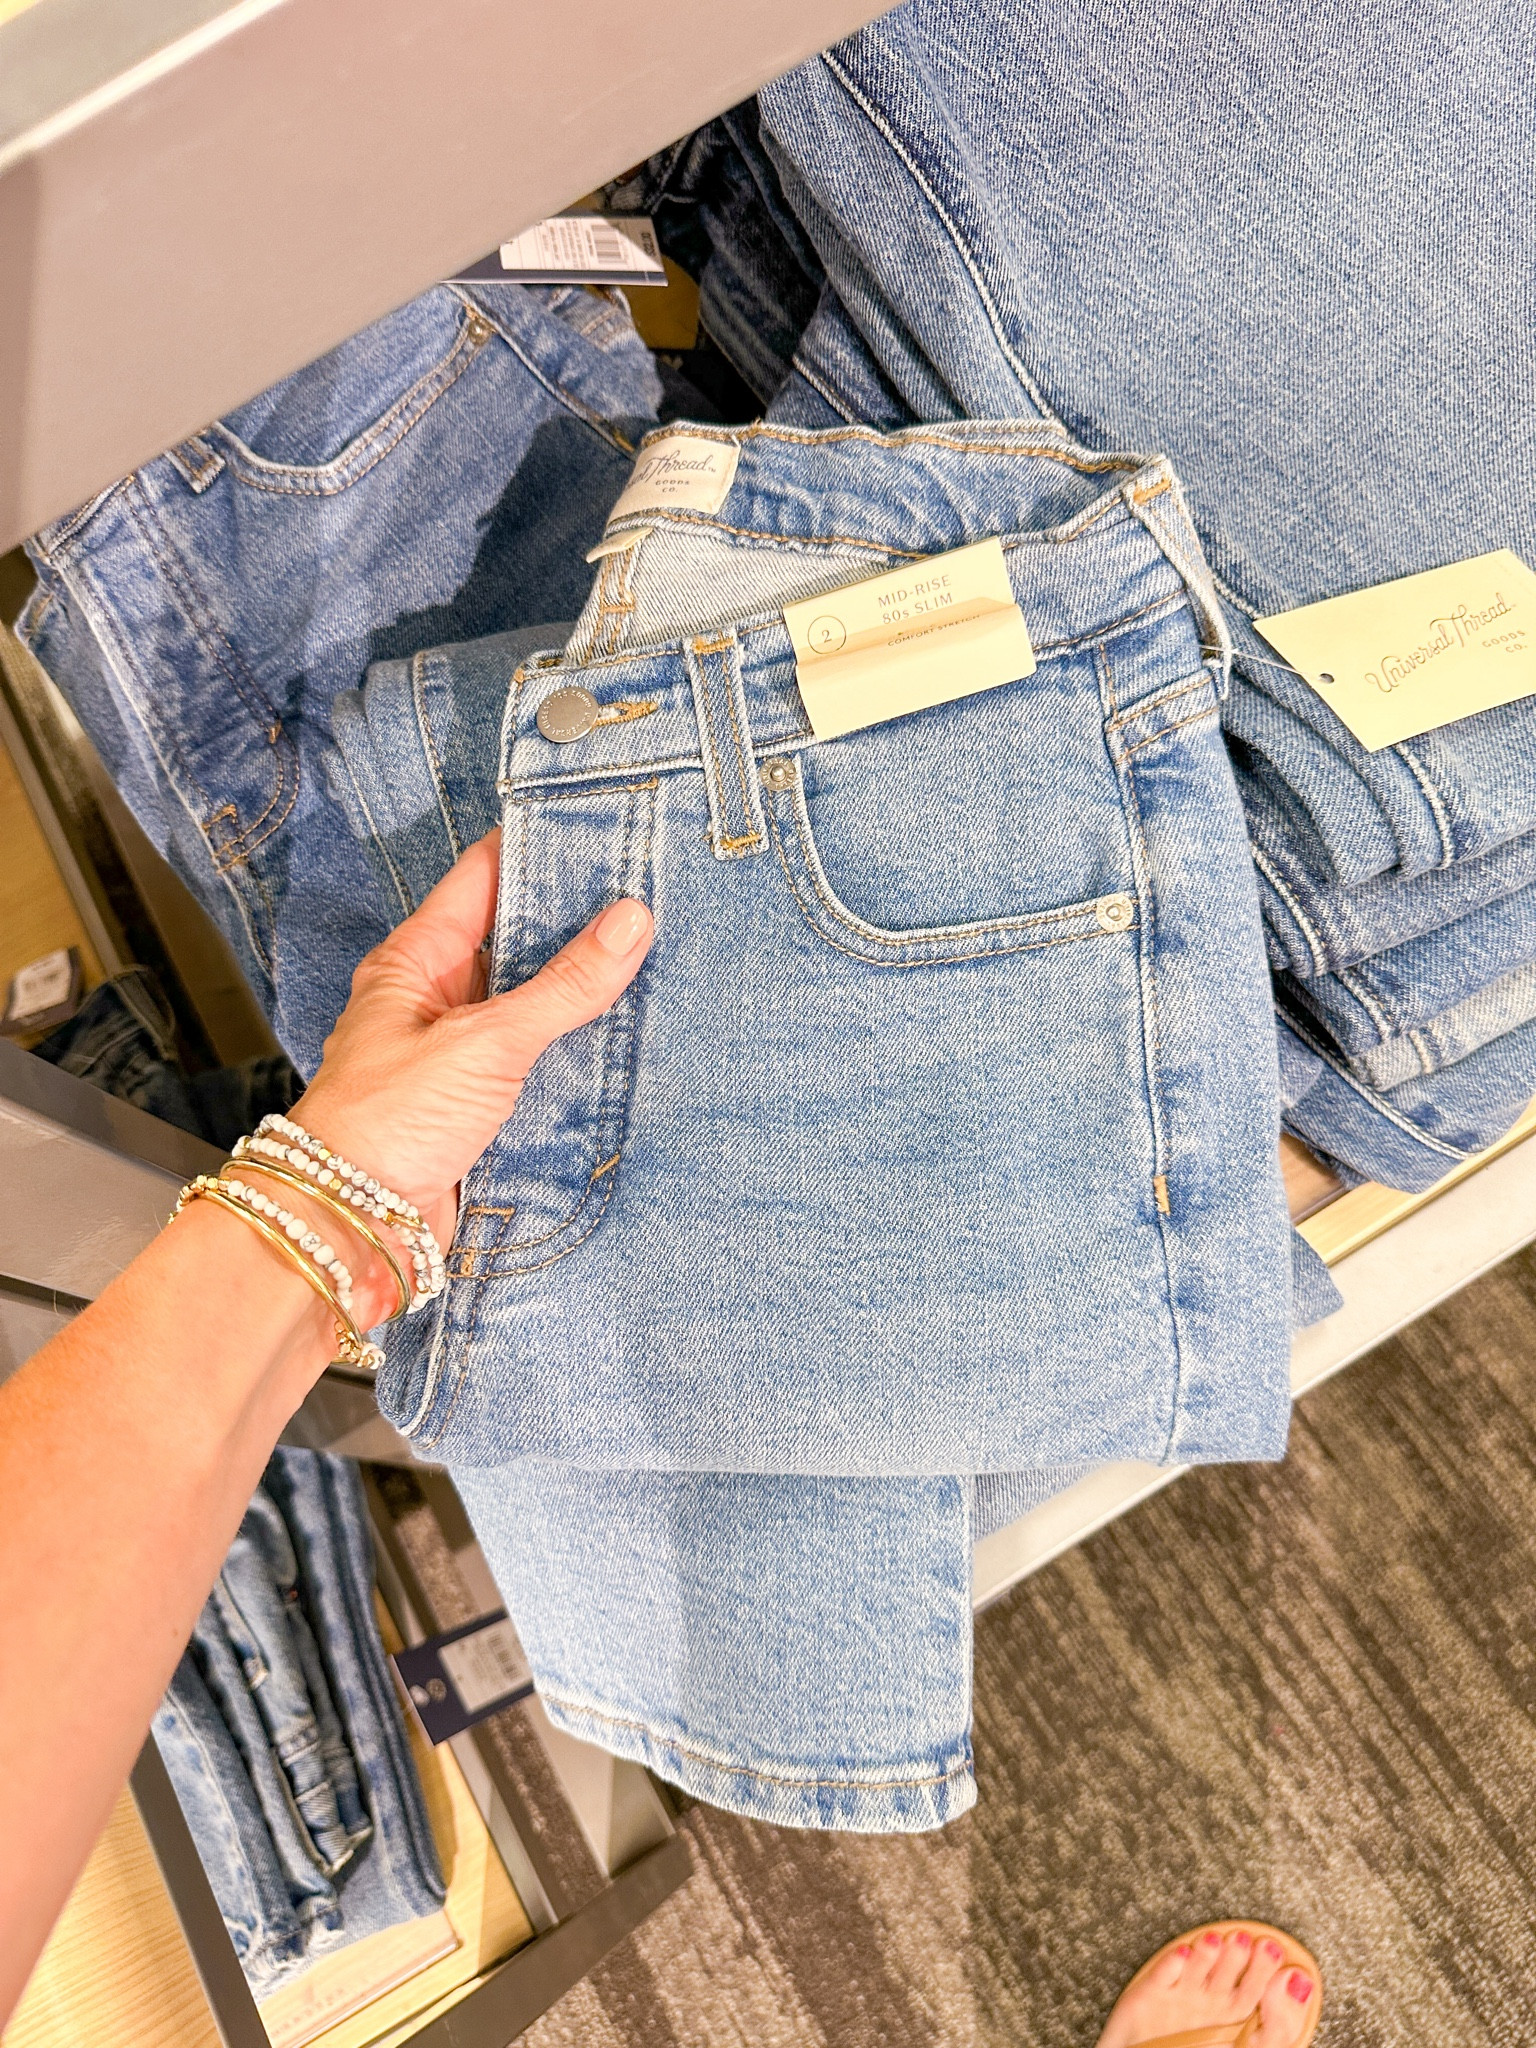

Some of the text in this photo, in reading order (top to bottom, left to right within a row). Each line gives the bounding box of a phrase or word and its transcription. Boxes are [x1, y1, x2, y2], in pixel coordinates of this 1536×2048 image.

[645, 449, 713, 483] Thread
[878, 574, 952, 608] MID-RISE
[882, 592, 953, 625] 80s SLIM
[821, 629, 833, 643] 2
[888, 629, 935, 647] COMFORT
[1364, 592, 1512, 693] Universal Thread
[1482, 629, 1526, 648] GOODS
[1505, 643, 1528, 654] CO.
